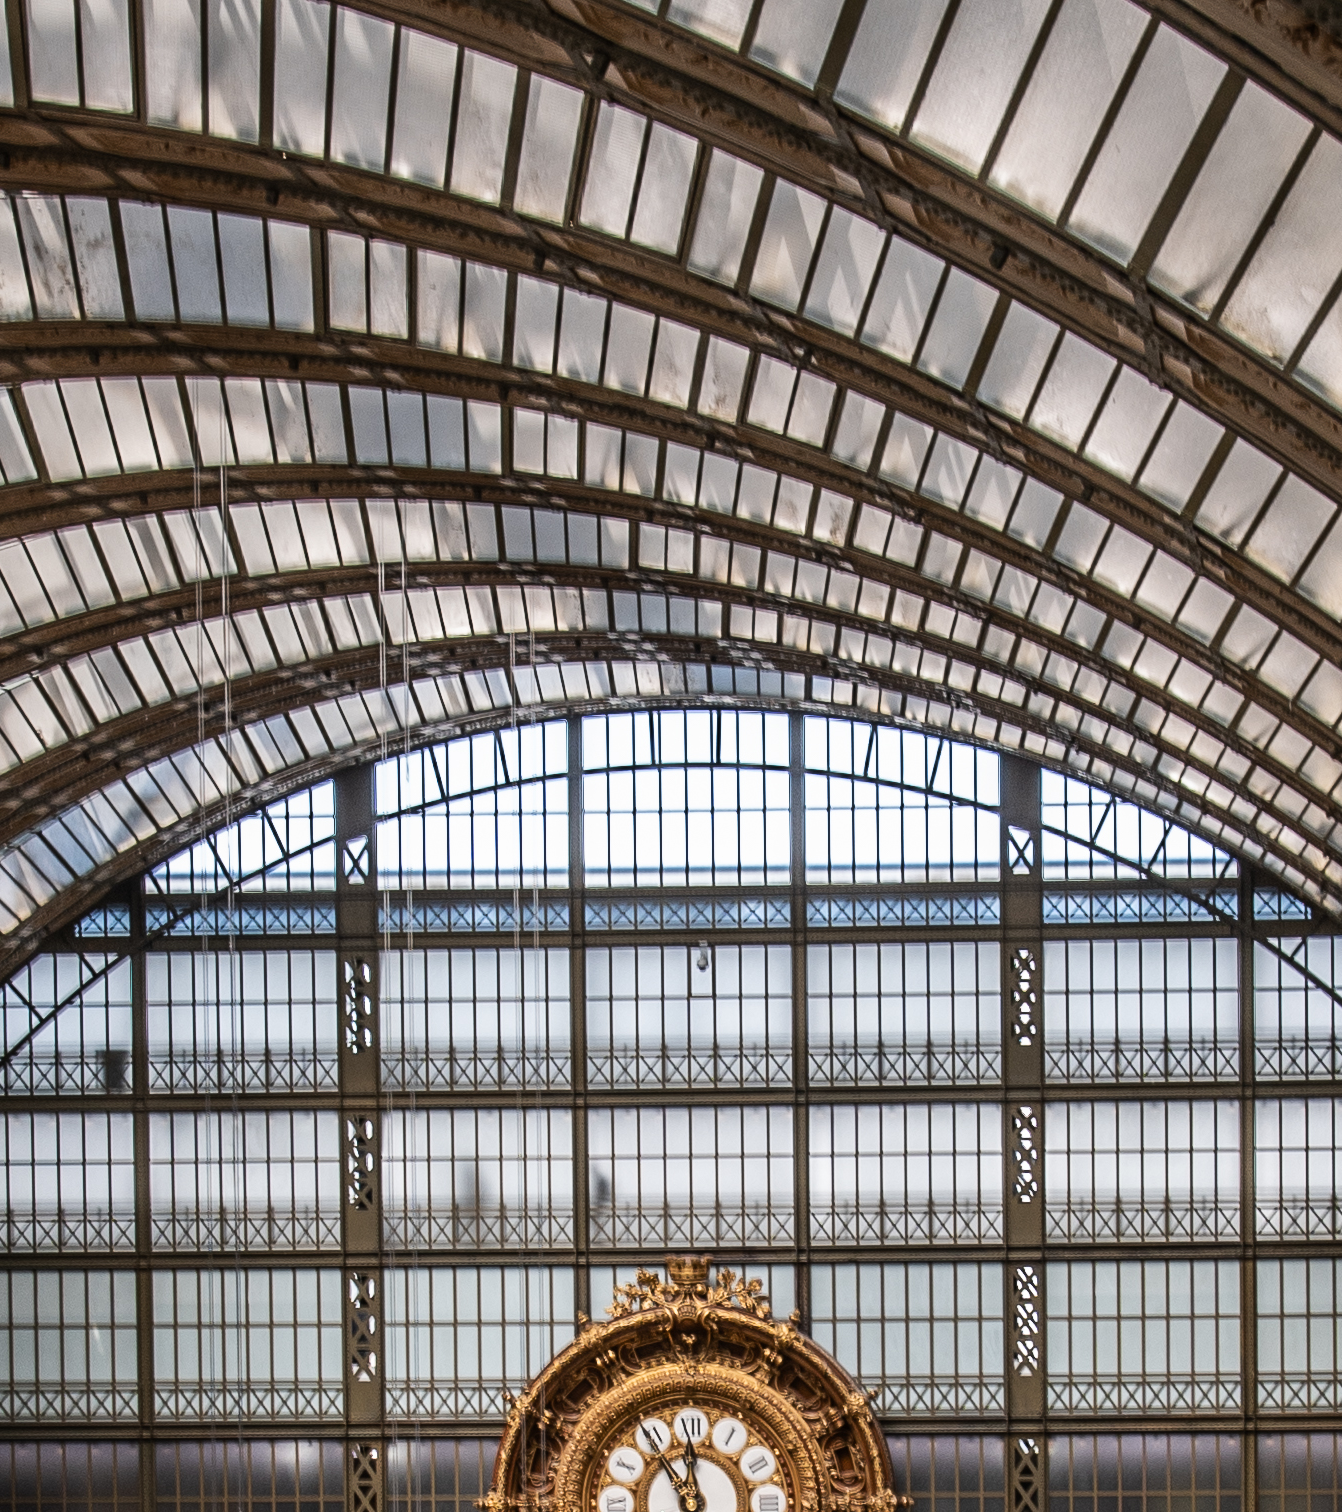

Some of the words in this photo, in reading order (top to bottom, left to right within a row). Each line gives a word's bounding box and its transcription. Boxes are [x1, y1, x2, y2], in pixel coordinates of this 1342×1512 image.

[724, 1426, 736, 1447] I
[615, 1456, 636, 1476] X
[747, 1455, 769, 1475] II
[606, 1494, 626, 1512] IX
[759, 1494, 779, 1512] III
